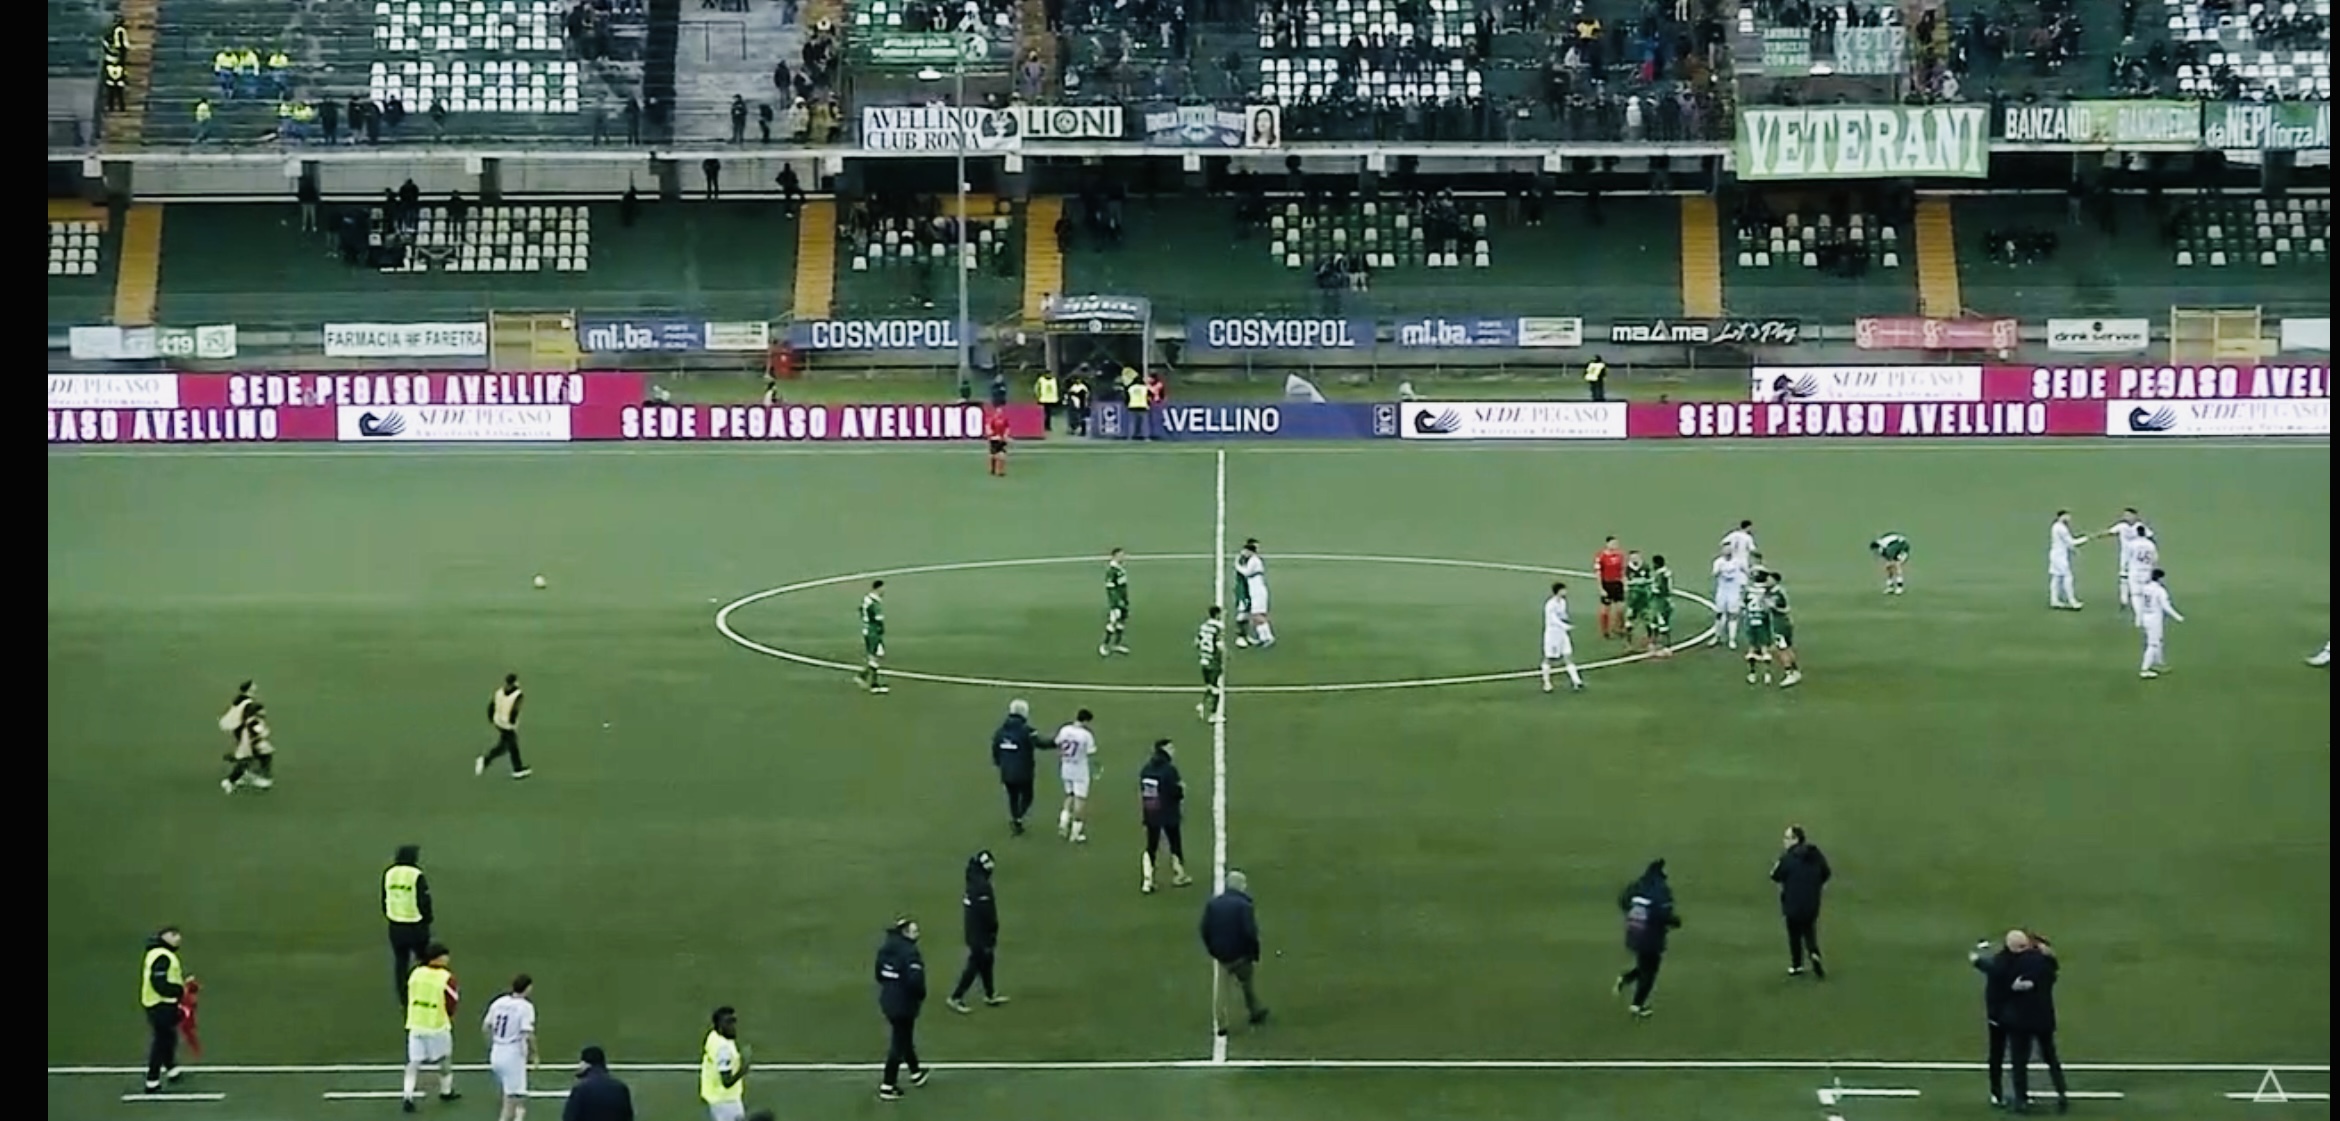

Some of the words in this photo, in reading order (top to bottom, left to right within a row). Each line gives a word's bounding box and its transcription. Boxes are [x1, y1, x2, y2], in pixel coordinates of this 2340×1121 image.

[869, 109, 978, 129] AVELLINO
[1027, 109, 1116, 135] LIONI
[2005, 107, 2090, 139] BANZANO
[867, 131, 917, 150] CLUB
[925, 131, 981, 150] ROMA
[1744, 108, 1986, 173] VETERANI
[327, 332, 400, 349] FARMACIA
[425, 330, 485, 347] FARETRA
[812, 321, 958, 348] COSMOPOL
[1209, 319, 1355, 347] COSMOPOL
[229, 376, 302, 406] SEDE
[315, 375, 430, 405] PEGASO
[445, 374, 583, 404] AVELLINO
[2032, 368, 2106, 398] SEDE
[2119, 367, 2238, 398] PEGASO
[132, 408, 277, 440] AVELLINO
[419, 409, 468, 425] SEDE
[621, 406, 697, 438] SEDE
[710, 406, 827, 438] PEGASO
[840, 405, 983, 438] AVELLINO
[1474, 407, 1523, 423] SEDE
[1678, 403, 1753, 436] SEDE
[1766, 403, 1886, 435] PEGASO
[1899, 402, 2047, 435] AVELLINO
[494, 1014, 508, 1038] 11
